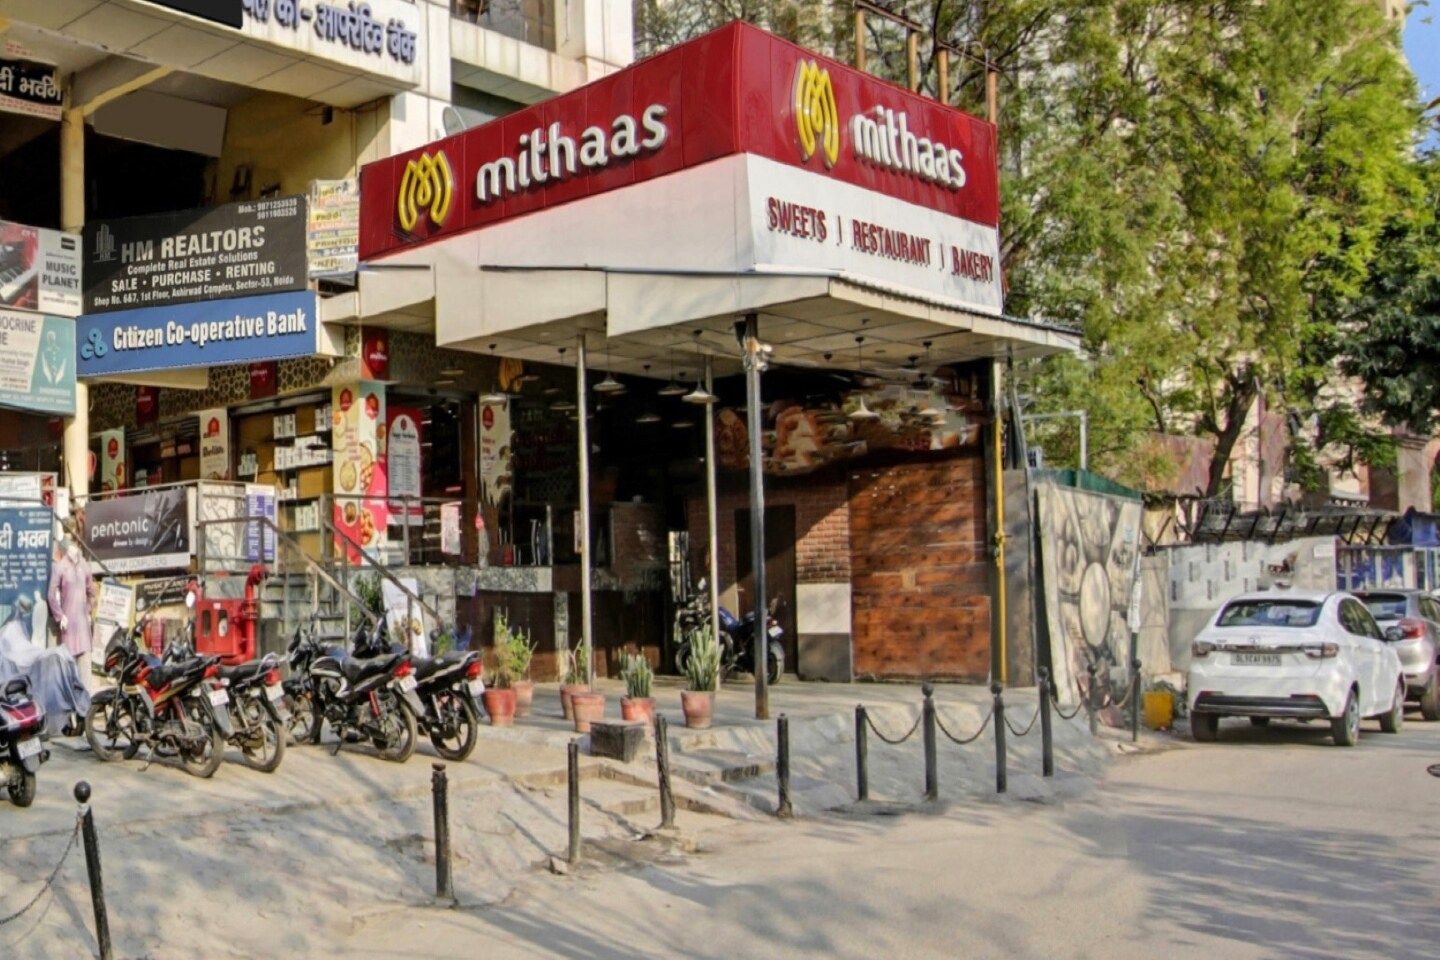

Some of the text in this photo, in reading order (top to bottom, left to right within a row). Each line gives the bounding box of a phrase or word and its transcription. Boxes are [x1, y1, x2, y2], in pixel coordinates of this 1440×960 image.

[386, 16, 417, 65] बैंक
[474, 103, 668, 204] mithaas
[848, 104, 968, 190] mithaas
[121, 225, 266, 264] HM REALTORS
[767, 196, 994, 284] SWEETS RESTAURANT BAKERY
[45, 261, 77, 277] MUSIC
[111, 261, 277, 294] SALE PURCHASE RENTING
[127, 251, 259, 276] Complete Real Estate Solutions
[42, 274, 80, 290] PLANET
[94, 295, 111, 308] Shop
[111, 294, 123, 306] No.
[140, 290, 153, 302] 1st
[152, 289, 172, 301] Floor,
[171, 286, 204, 299] Ashirwad
[203, 283, 236, 296] Complex,
[273, 275, 296, 287] Noida
[113, 307, 308, 352] Citizen Co-operative Bank
[17, 529, 51, 549] भवन
[91, 517, 150, 542] pentonic
